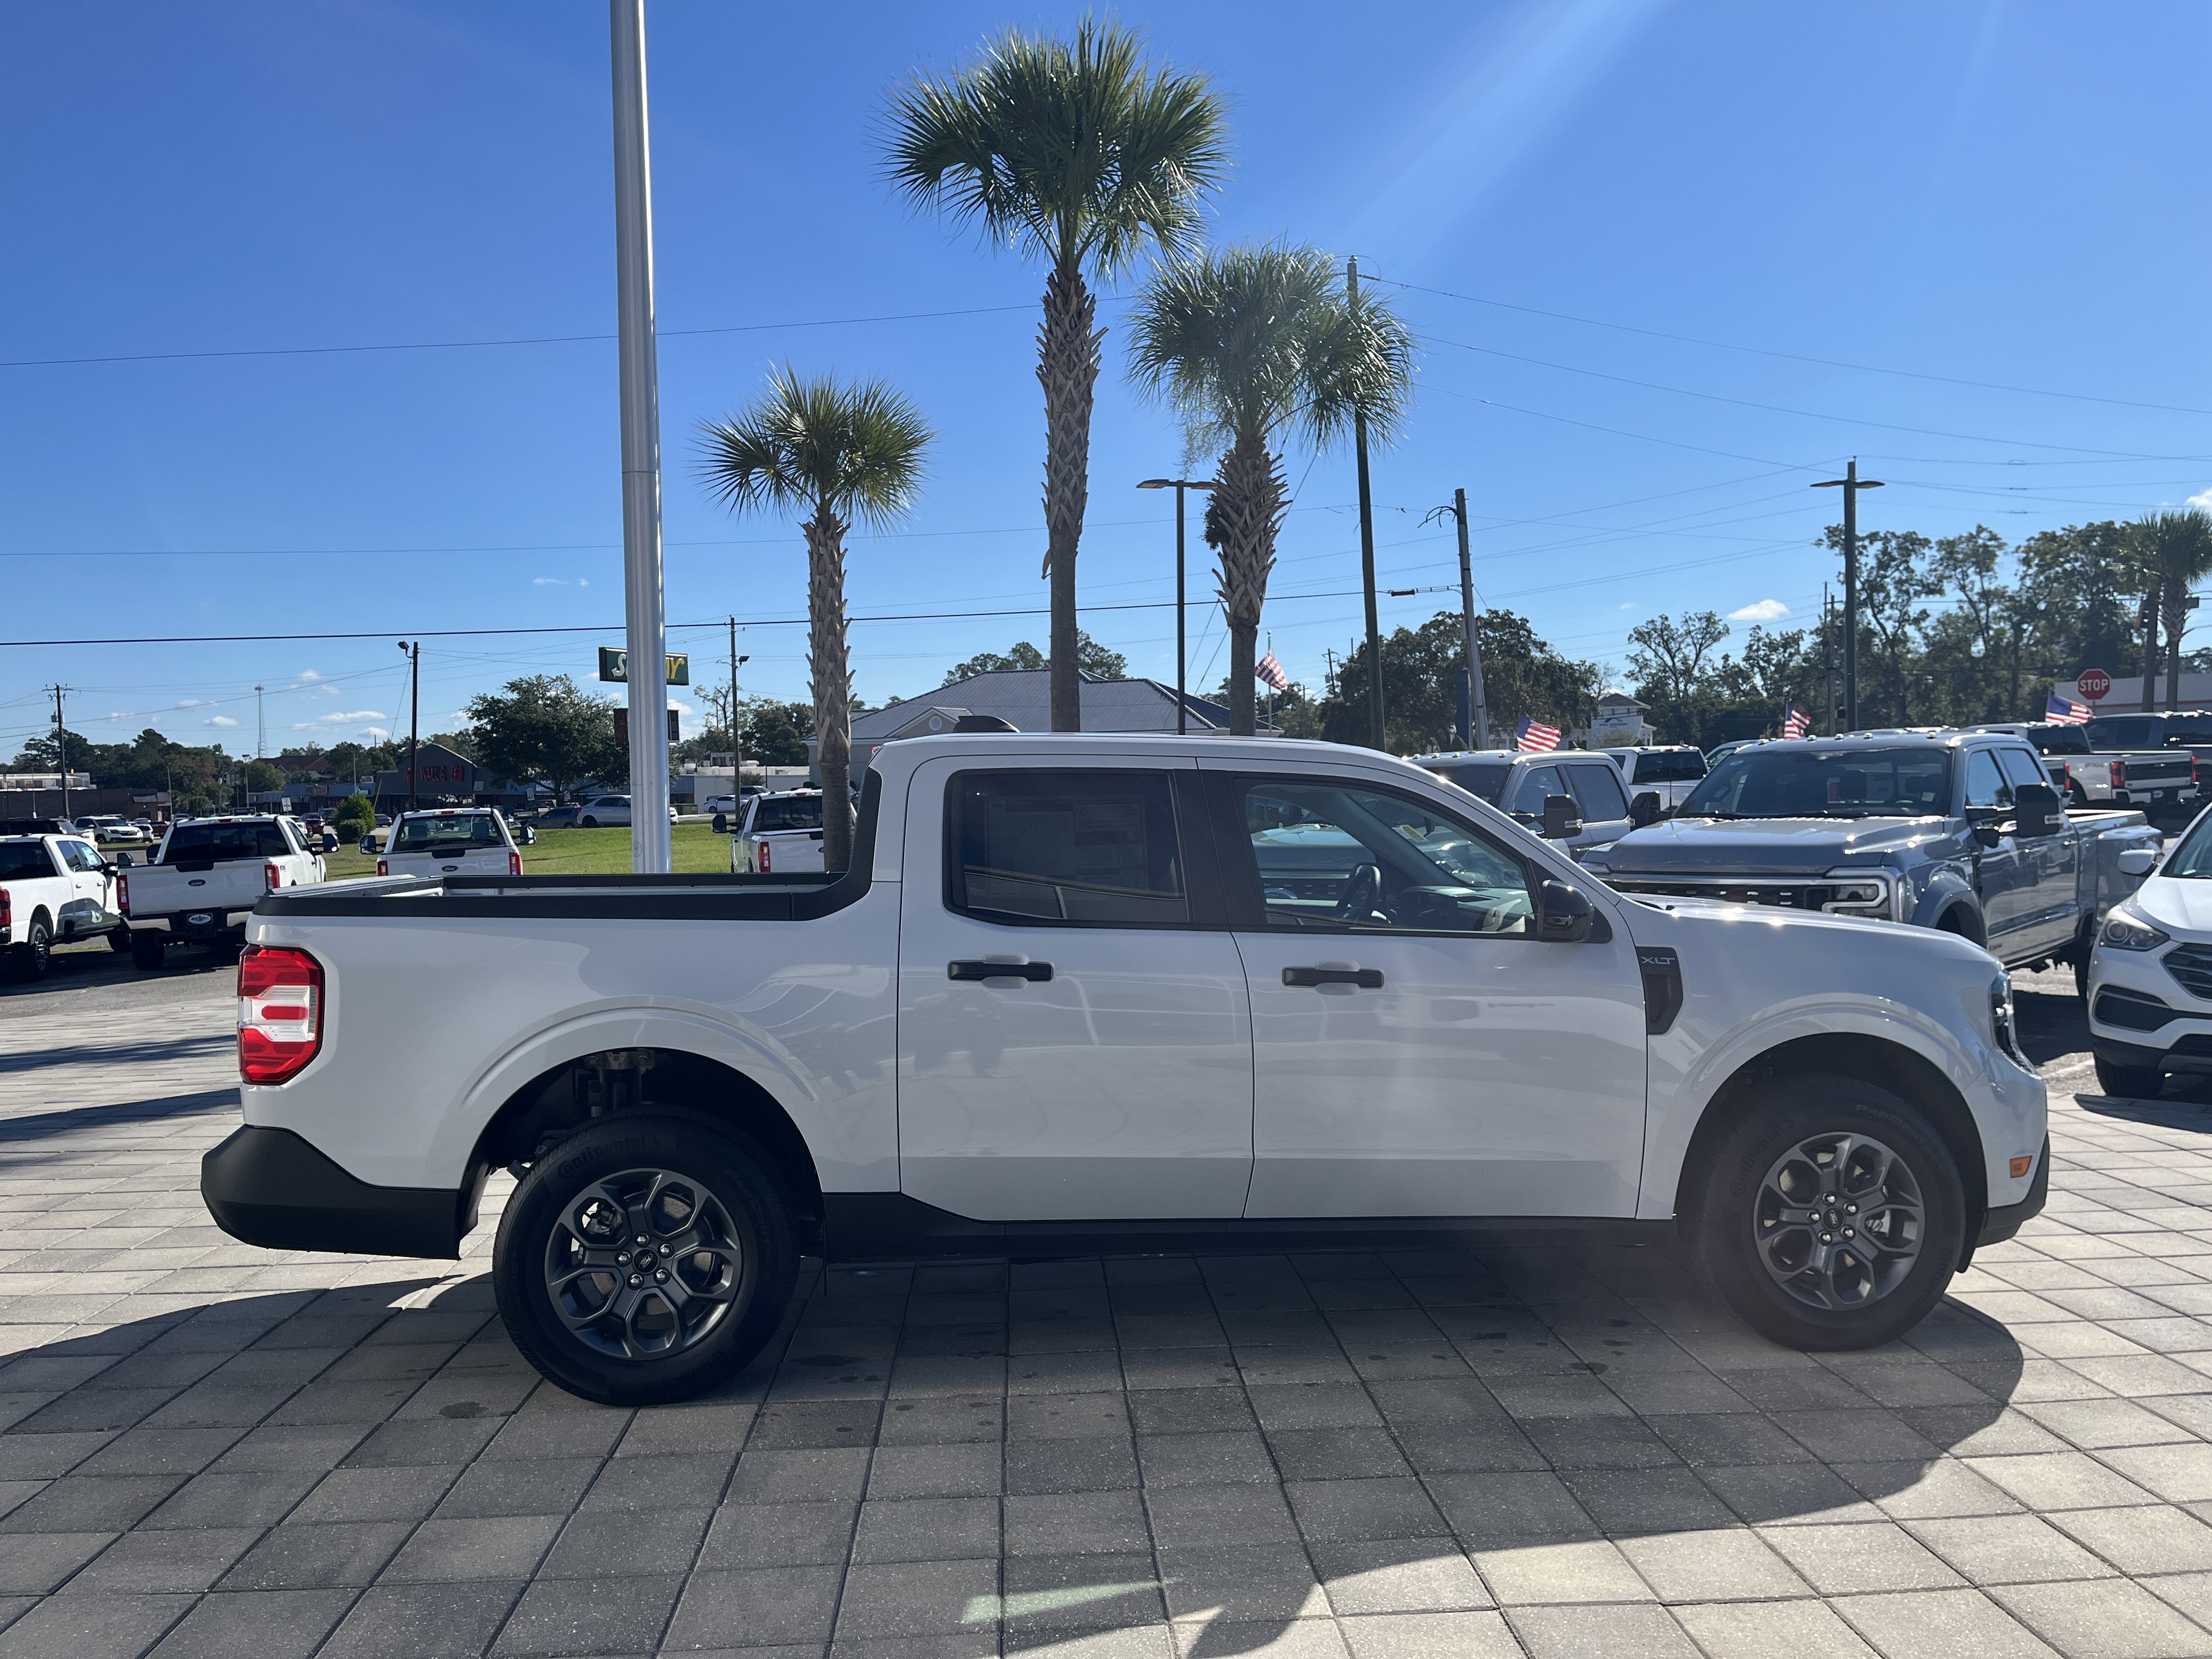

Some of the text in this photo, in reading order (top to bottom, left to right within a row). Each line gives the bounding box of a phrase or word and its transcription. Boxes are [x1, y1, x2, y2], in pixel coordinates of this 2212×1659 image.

[2079, 679, 2109, 691] STOP
[1641, 956, 1675, 964] XLT
[557, 1134, 646, 1178] Continental
